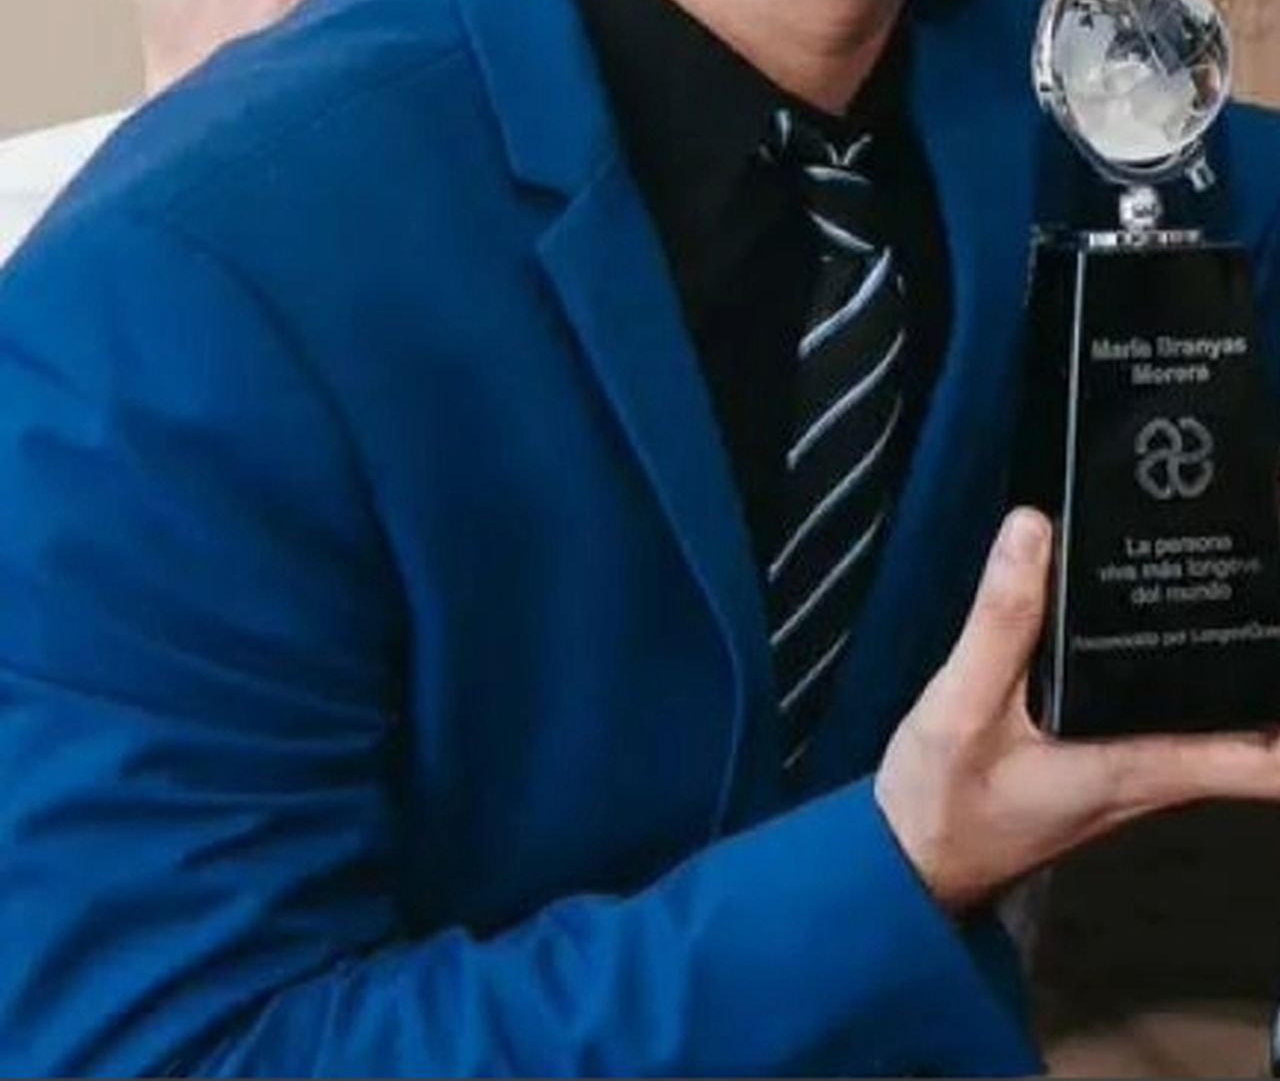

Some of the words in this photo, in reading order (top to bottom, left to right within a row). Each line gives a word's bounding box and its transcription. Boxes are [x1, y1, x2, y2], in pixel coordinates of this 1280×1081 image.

[1156, 336, 1248, 360] Branyas
[1131, 363, 1210, 385] Morera
[1126, 538, 1151, 556] La
[1155, 535, 1233, 556] persona
[1131, 585, 1160, 604] del
[1166, 582, 1233, 601] mundo
